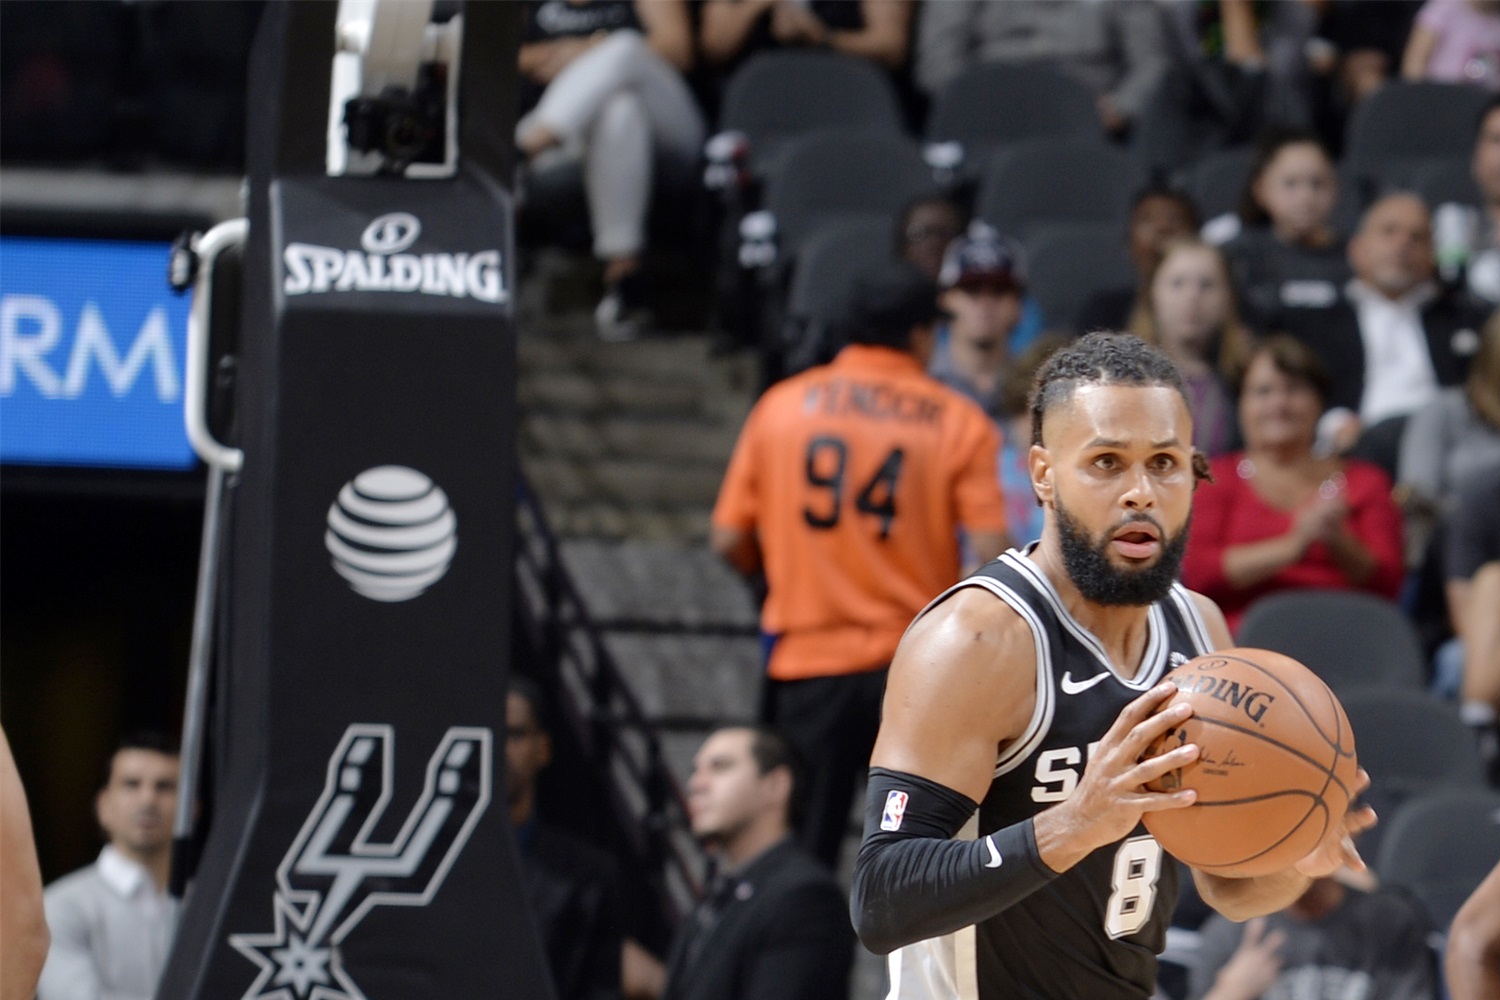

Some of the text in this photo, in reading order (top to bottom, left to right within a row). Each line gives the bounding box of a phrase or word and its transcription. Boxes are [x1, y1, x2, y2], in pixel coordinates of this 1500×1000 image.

[284, 242, 507, 303] SPALDING
[803, 434, 905, 543] 94
[1104, 834, 1163, 941] 8
